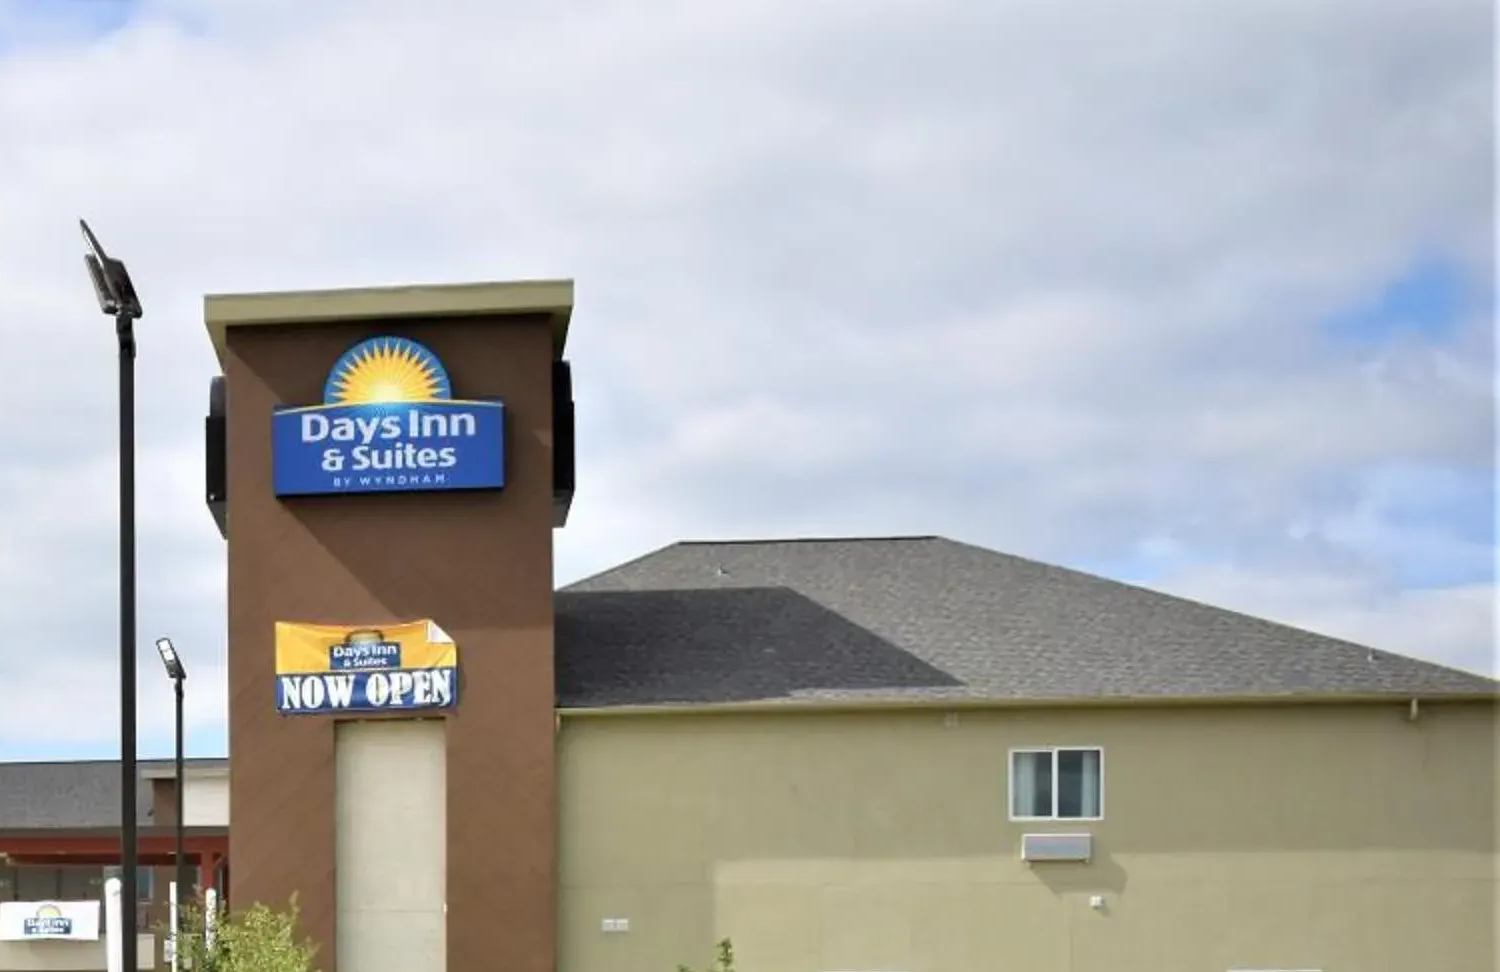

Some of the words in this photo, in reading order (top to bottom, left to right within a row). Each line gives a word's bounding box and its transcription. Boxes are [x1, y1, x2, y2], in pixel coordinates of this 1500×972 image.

[301, 412, 402, 444] Days
[408, 409, 476, 438] Inn
[321, 448, 344, 472] &
[352, 442, 457, 470] Suites
[333, 476, 351, 488] BY
[360, 473, 445, 486] WYNDHAM
[333, 645, 370, 658] Days
[281, 674, 355, 710] NOW
[365, 669, 451, 706] OPEN
